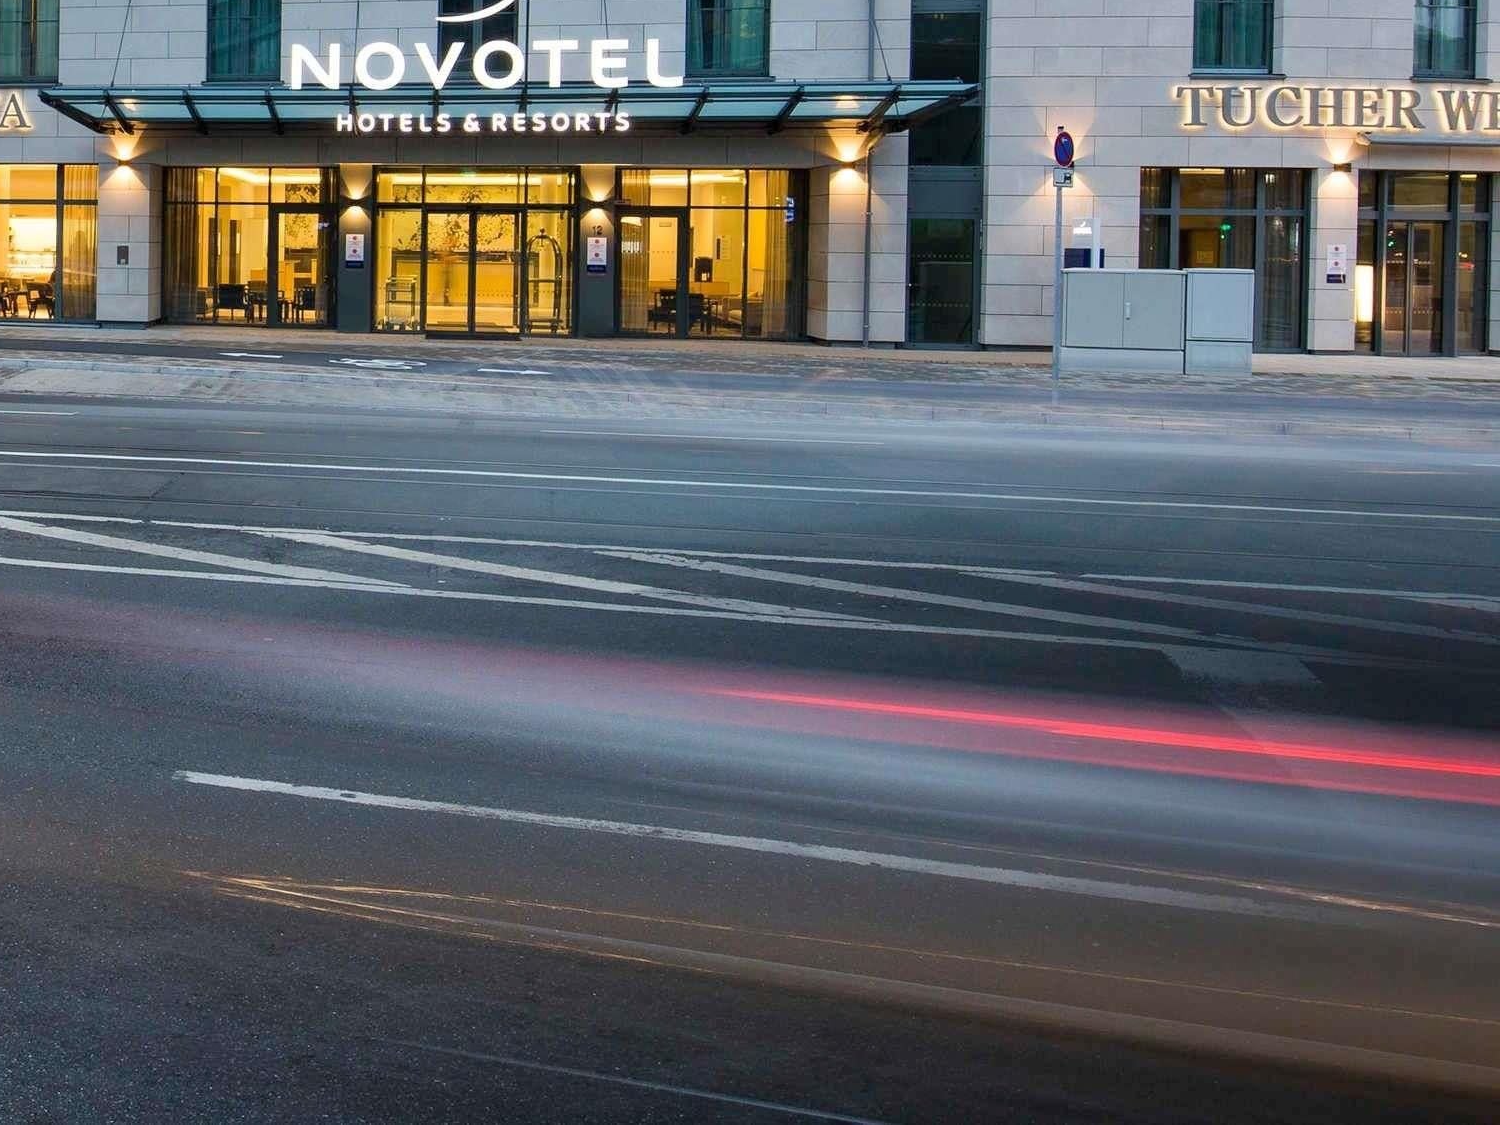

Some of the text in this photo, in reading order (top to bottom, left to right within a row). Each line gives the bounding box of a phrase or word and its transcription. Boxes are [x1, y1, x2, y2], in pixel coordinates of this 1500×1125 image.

[290, 38, 684, 90] NOVOTEL
[336, 111, 631, 133] HOTELS & RESORTS
[1176, 86, 1426, 129] TUCHER
[592, 225, 604, 236] 12
